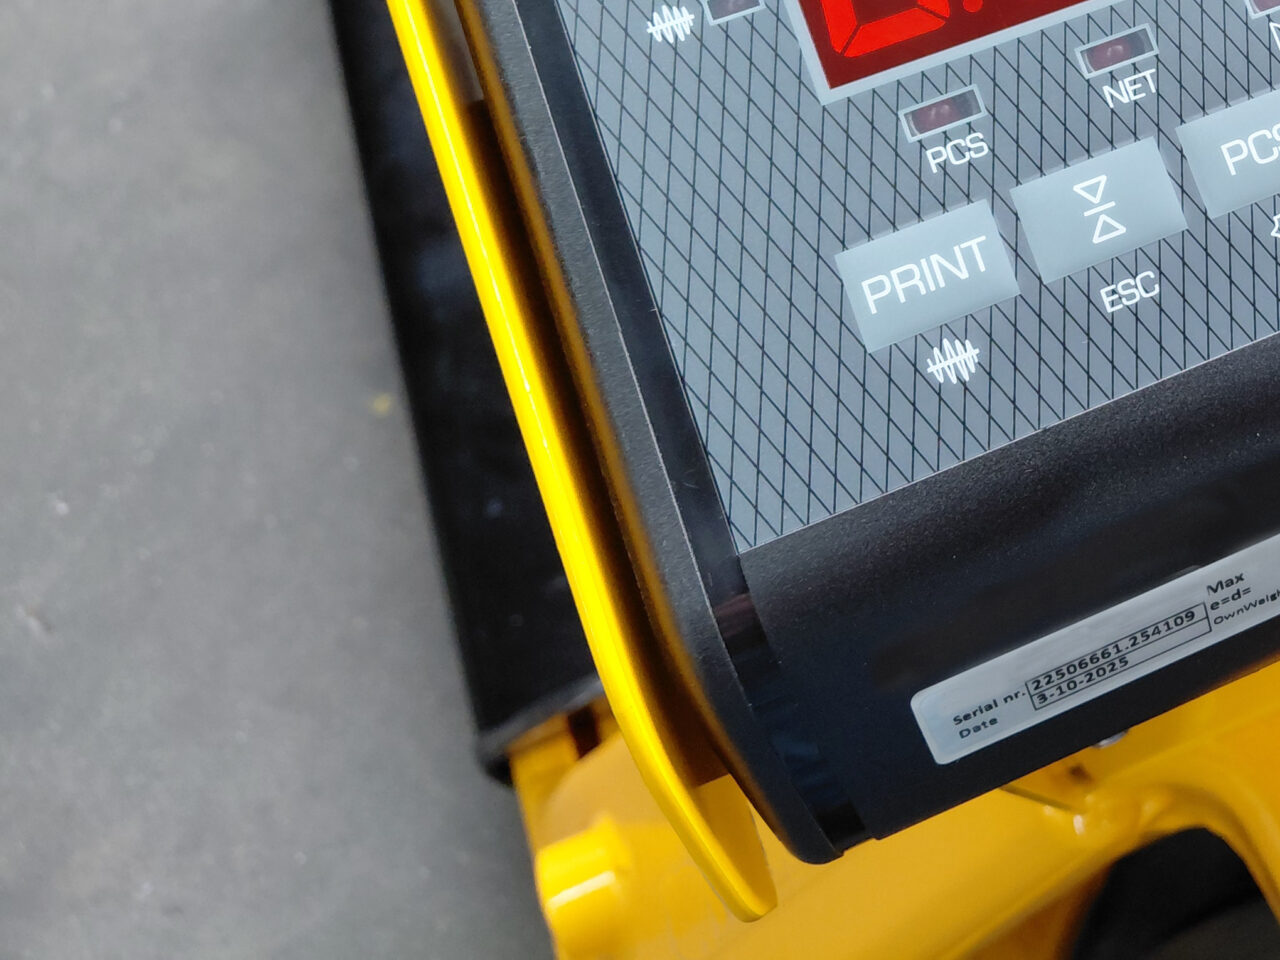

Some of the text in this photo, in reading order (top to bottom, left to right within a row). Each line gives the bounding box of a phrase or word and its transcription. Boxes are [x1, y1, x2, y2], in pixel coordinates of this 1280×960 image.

[1102, 68, 1158, 108] NET
[925, 131, 989, 174] PCS
[861, 235, 987, 315] PRINT
[1099, 270, 1160, 313] ESC
[1206, 572, 1246, 596] Max
[952, 610, 1197, 726] Serial nr. 22506661.254109
[959, 657, 1130, 739] Date 3-10-2025
